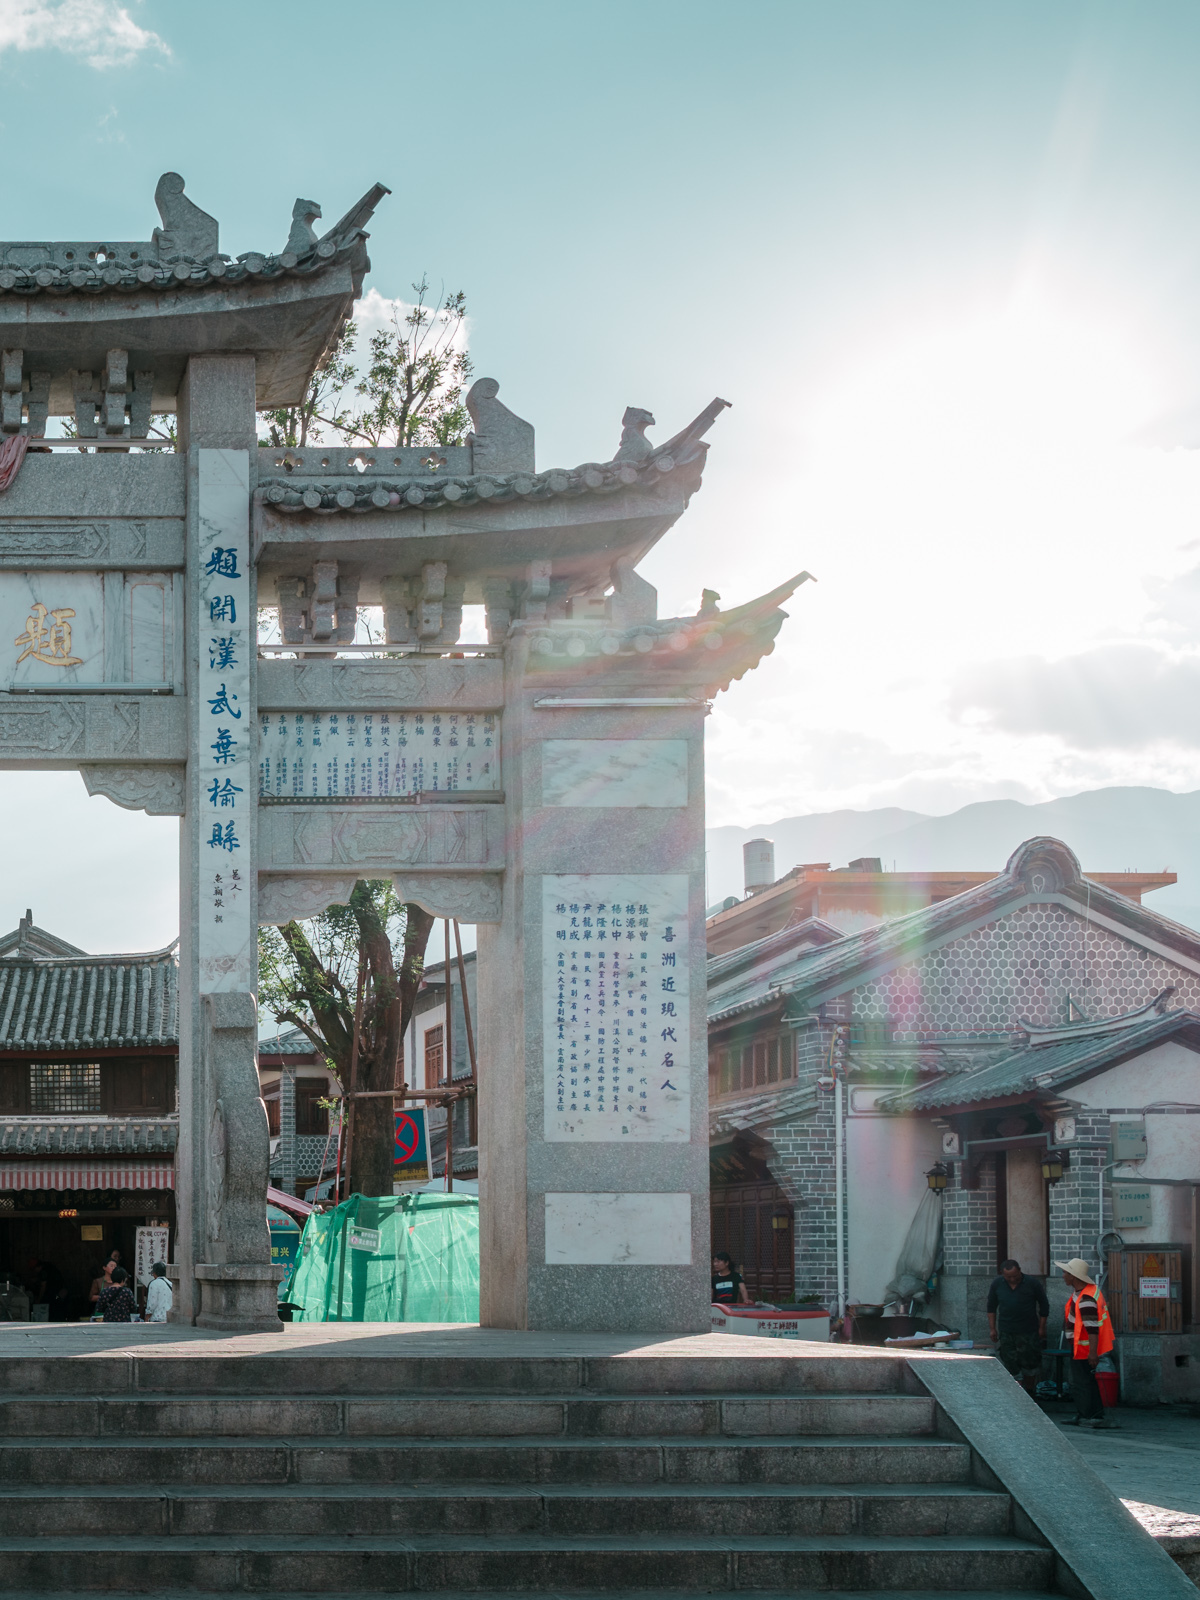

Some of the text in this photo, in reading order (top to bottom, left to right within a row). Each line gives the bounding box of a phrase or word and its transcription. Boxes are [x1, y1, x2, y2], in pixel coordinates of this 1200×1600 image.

[569, 904, 580, 941] 楊克成
[611, 904, 622, 941] 楊化中
[660, 926, 677, 1092] 喜洲近現代名人
